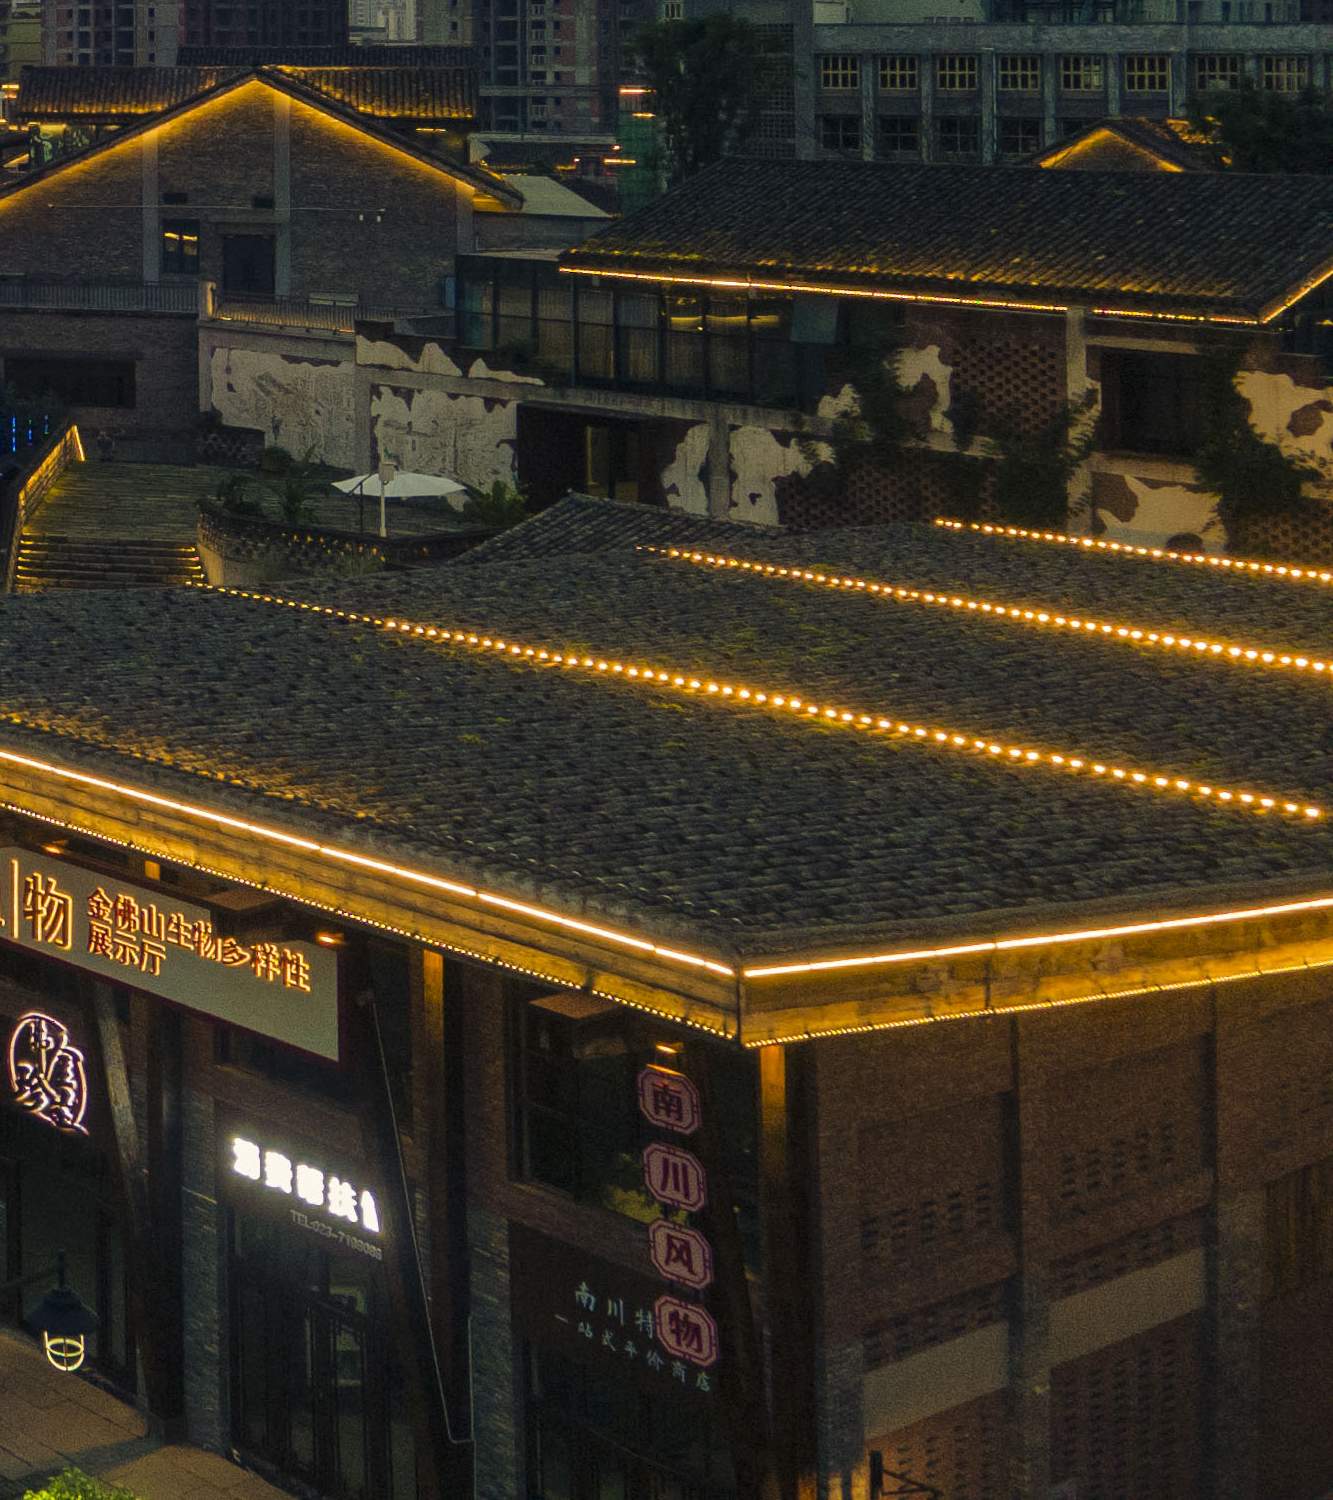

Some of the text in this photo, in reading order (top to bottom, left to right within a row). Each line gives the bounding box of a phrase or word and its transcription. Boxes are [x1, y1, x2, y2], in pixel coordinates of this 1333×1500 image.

[87, 886, 311, 993] 金佛山生物多样性
[89, 919, 167, 977] 展示厅
[651, 1081, 704, 1354] 南川风物
